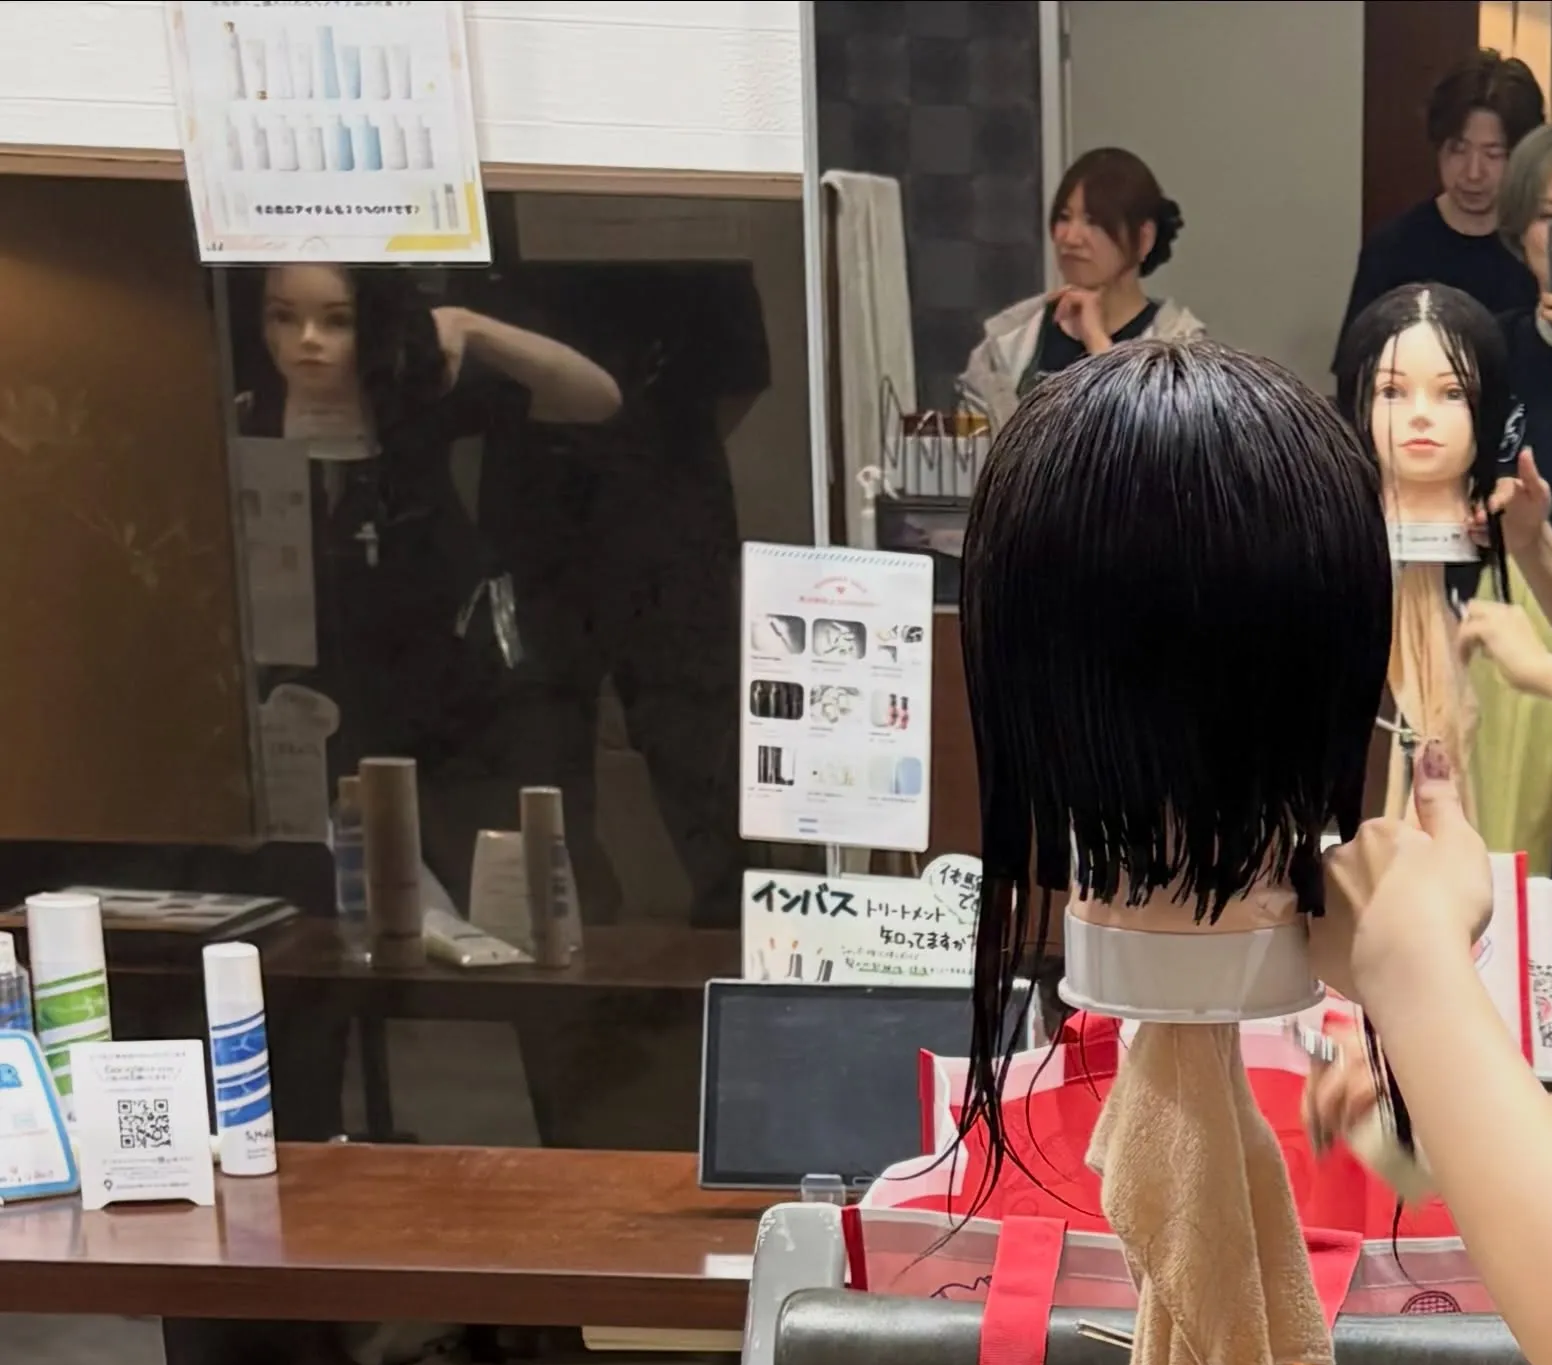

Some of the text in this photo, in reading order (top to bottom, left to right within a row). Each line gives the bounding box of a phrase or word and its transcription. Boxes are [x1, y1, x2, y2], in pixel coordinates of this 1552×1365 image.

[752, 880, 947, 923] インバス トリートメント
